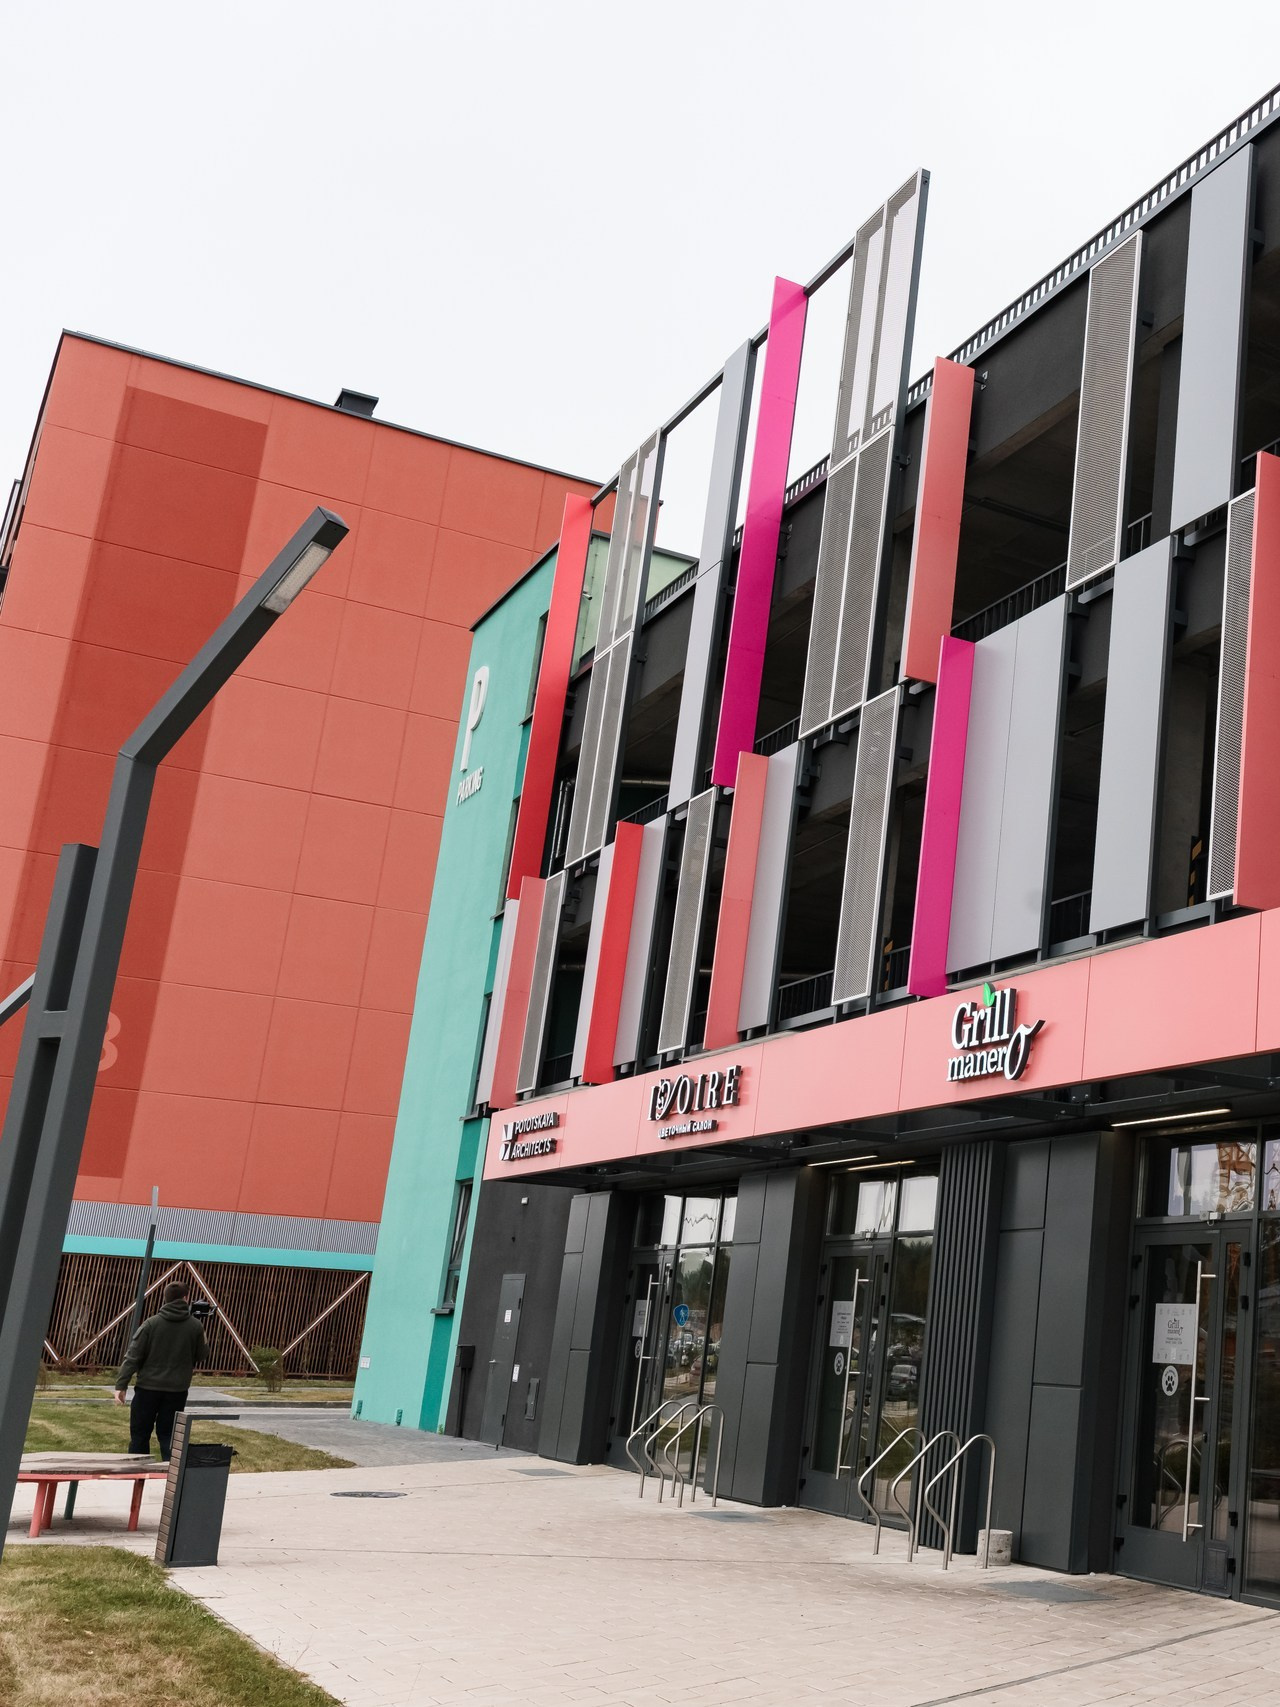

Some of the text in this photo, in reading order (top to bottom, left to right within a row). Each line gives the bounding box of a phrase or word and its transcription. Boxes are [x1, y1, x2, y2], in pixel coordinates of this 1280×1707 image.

[460, 665, 490, 772] P
[456, 765, 484, 806] PARKING
[951, 983, 1015, 1050] Grill
[515, 1112, 556, 1135] POTOTSKAYA
[658, 1119, 715, 1138] ЦВЕТОЧНЫЙ САЛОН
[510, 1138, 554, 1159] ARCHITECTS
